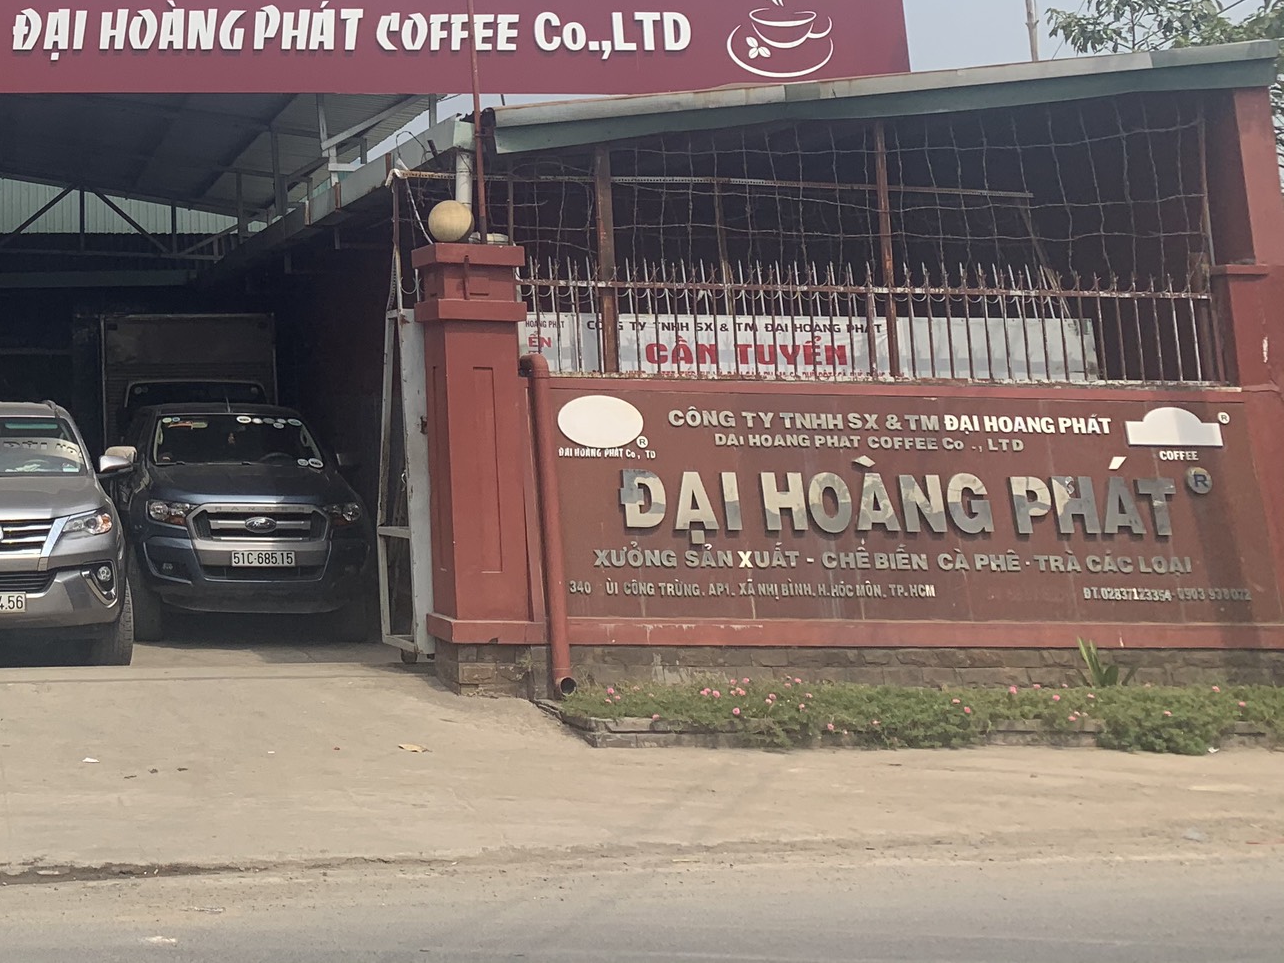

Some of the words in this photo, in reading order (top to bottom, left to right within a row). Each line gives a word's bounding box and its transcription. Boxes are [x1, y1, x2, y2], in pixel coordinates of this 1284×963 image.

[12, 7, 88, 61] ĐẠI
[99, 0, 247, 51] HOÀNG
[253, 0, 364, 51] PHÁT
[376, 12, 520, 51] COFFEE
[533, 11, 692, 60] Co.,LTD
[719, 323, 729, 332] &
[645, 334, 717, 365] CẦN
[736, 335, 847, 366] TUYỂN
[668, 406, 736, 427] CÔNG
[741, 411, 774, 428] TY
[779, 412, 844, 430] TNHH
[847, 413, 880, 430] SX
[885, 414, 904, 430] &
[904, 414, 940, 431] TM
[943, 414, 981, 435] ĐẠI
[748, 434, 811, 448] HOANG
[814, 435, 861, 448] PHAT
[867, 435, 938, 450] COFFEE
[1159, 450, 1200, 461] COFFEE
[620, 468, 743, 545] ĐẠI
[760, 455, 994, 534] HOÀNG
[1008, 456, 1176, 537] PHÁT
[593, 540, 678, 568] XƯỞNG
[685, 543, 734, 568] SẢN
[736, 541, 800, 568] XUẤT
[874, 542, 929, 571] BIẾN
[937, 547, 970, 572] CÀ
[973, 548, 1021, 572] PHÊ
[1033, 548, 1082, 573] TRÀ
[1086, 549, 1134, 574] CÁC
[569, 580, 592, 594] 340
[623, 578, 656, 596] CÔNG
